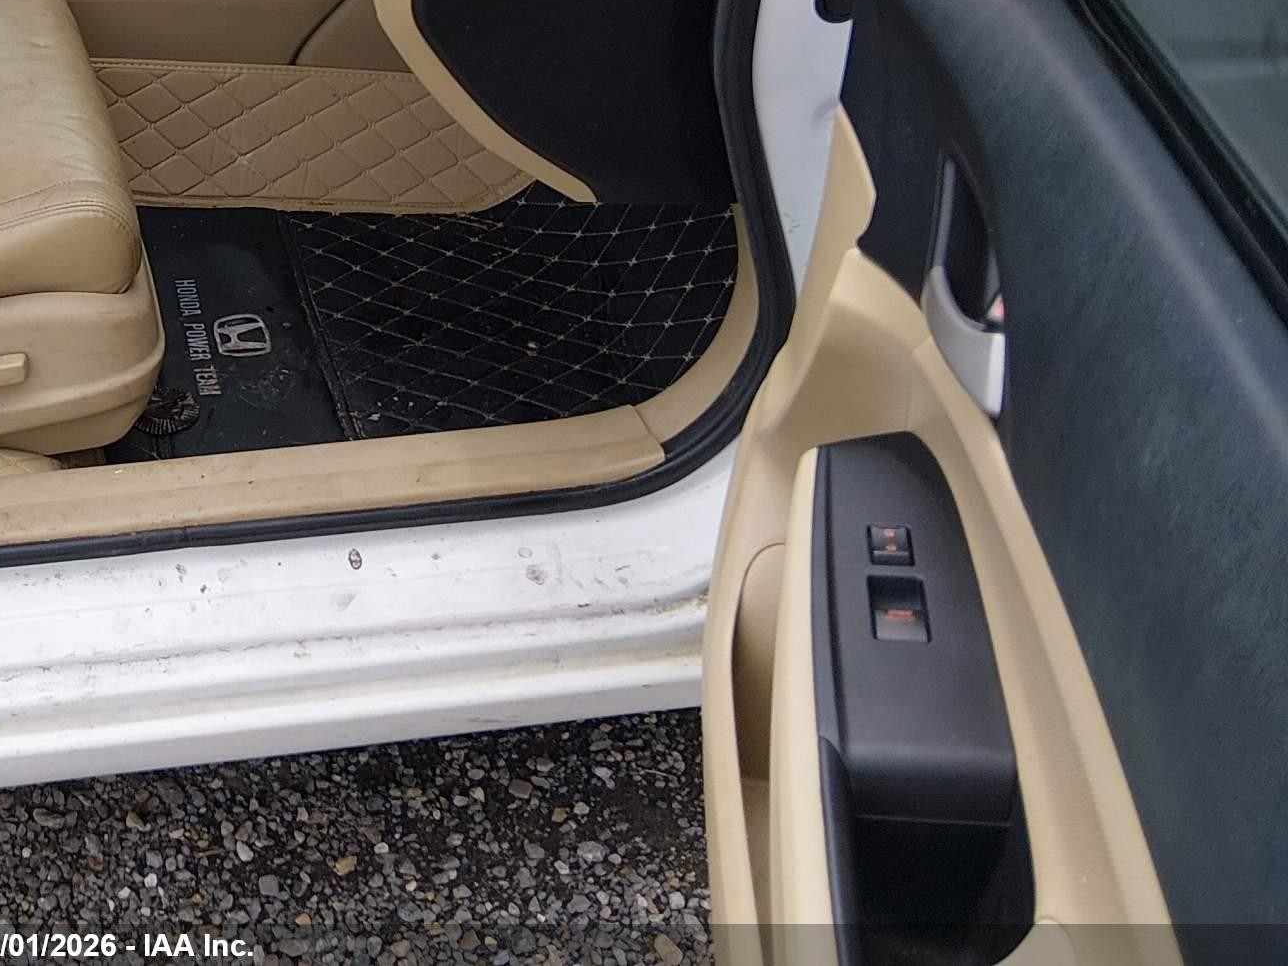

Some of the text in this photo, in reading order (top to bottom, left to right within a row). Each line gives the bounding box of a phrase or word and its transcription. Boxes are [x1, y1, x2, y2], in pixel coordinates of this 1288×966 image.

[174, 279, 222, 395] HONDA POWER TEAM
